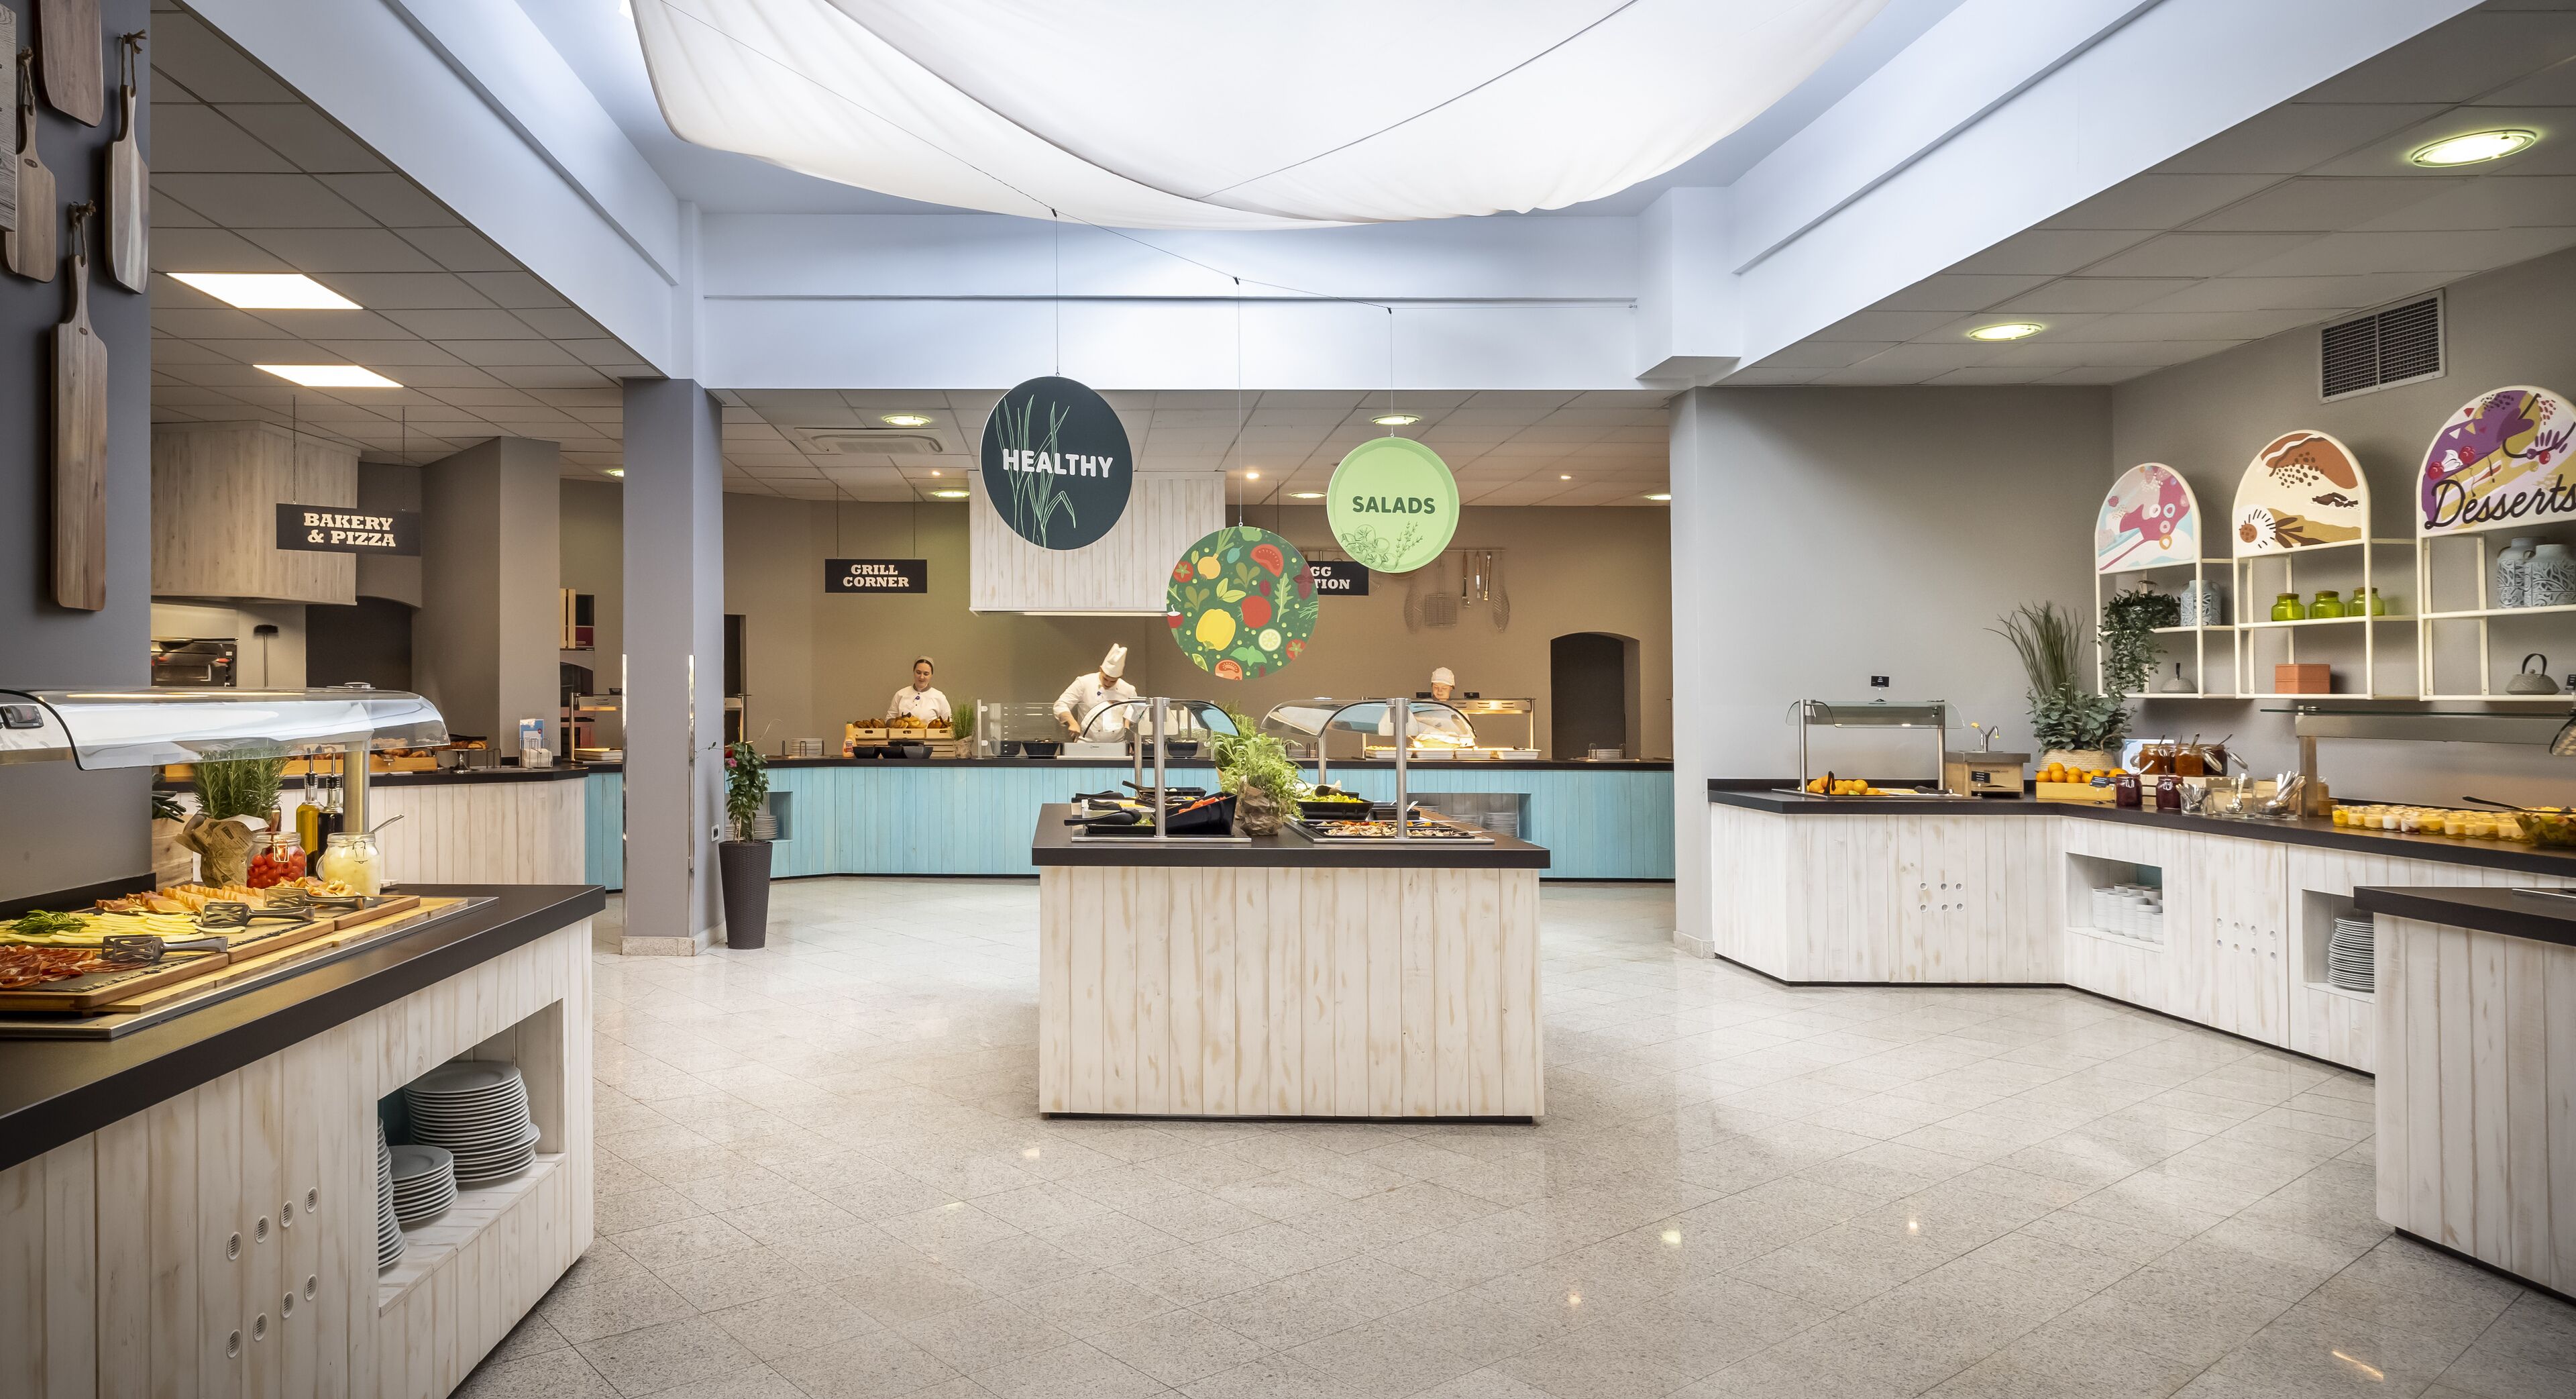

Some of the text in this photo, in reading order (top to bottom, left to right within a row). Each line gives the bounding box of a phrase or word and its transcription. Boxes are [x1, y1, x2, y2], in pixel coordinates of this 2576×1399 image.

[1003, 448, 1114, 478] HEALTHY
[1352, 496, 1436, 514] SALADS
[2424, 474, 2576, 530] Desserts
[304, 513, 393, 531] BAKERY
[307, 529, 396, 547] & PIZZA
[851, 564, 898, 575] GRILL
[1310, 566, 1332, 576] GG
[843, 576, 910, 587] CORNER
[1314, 578, 1350, 589] TION
